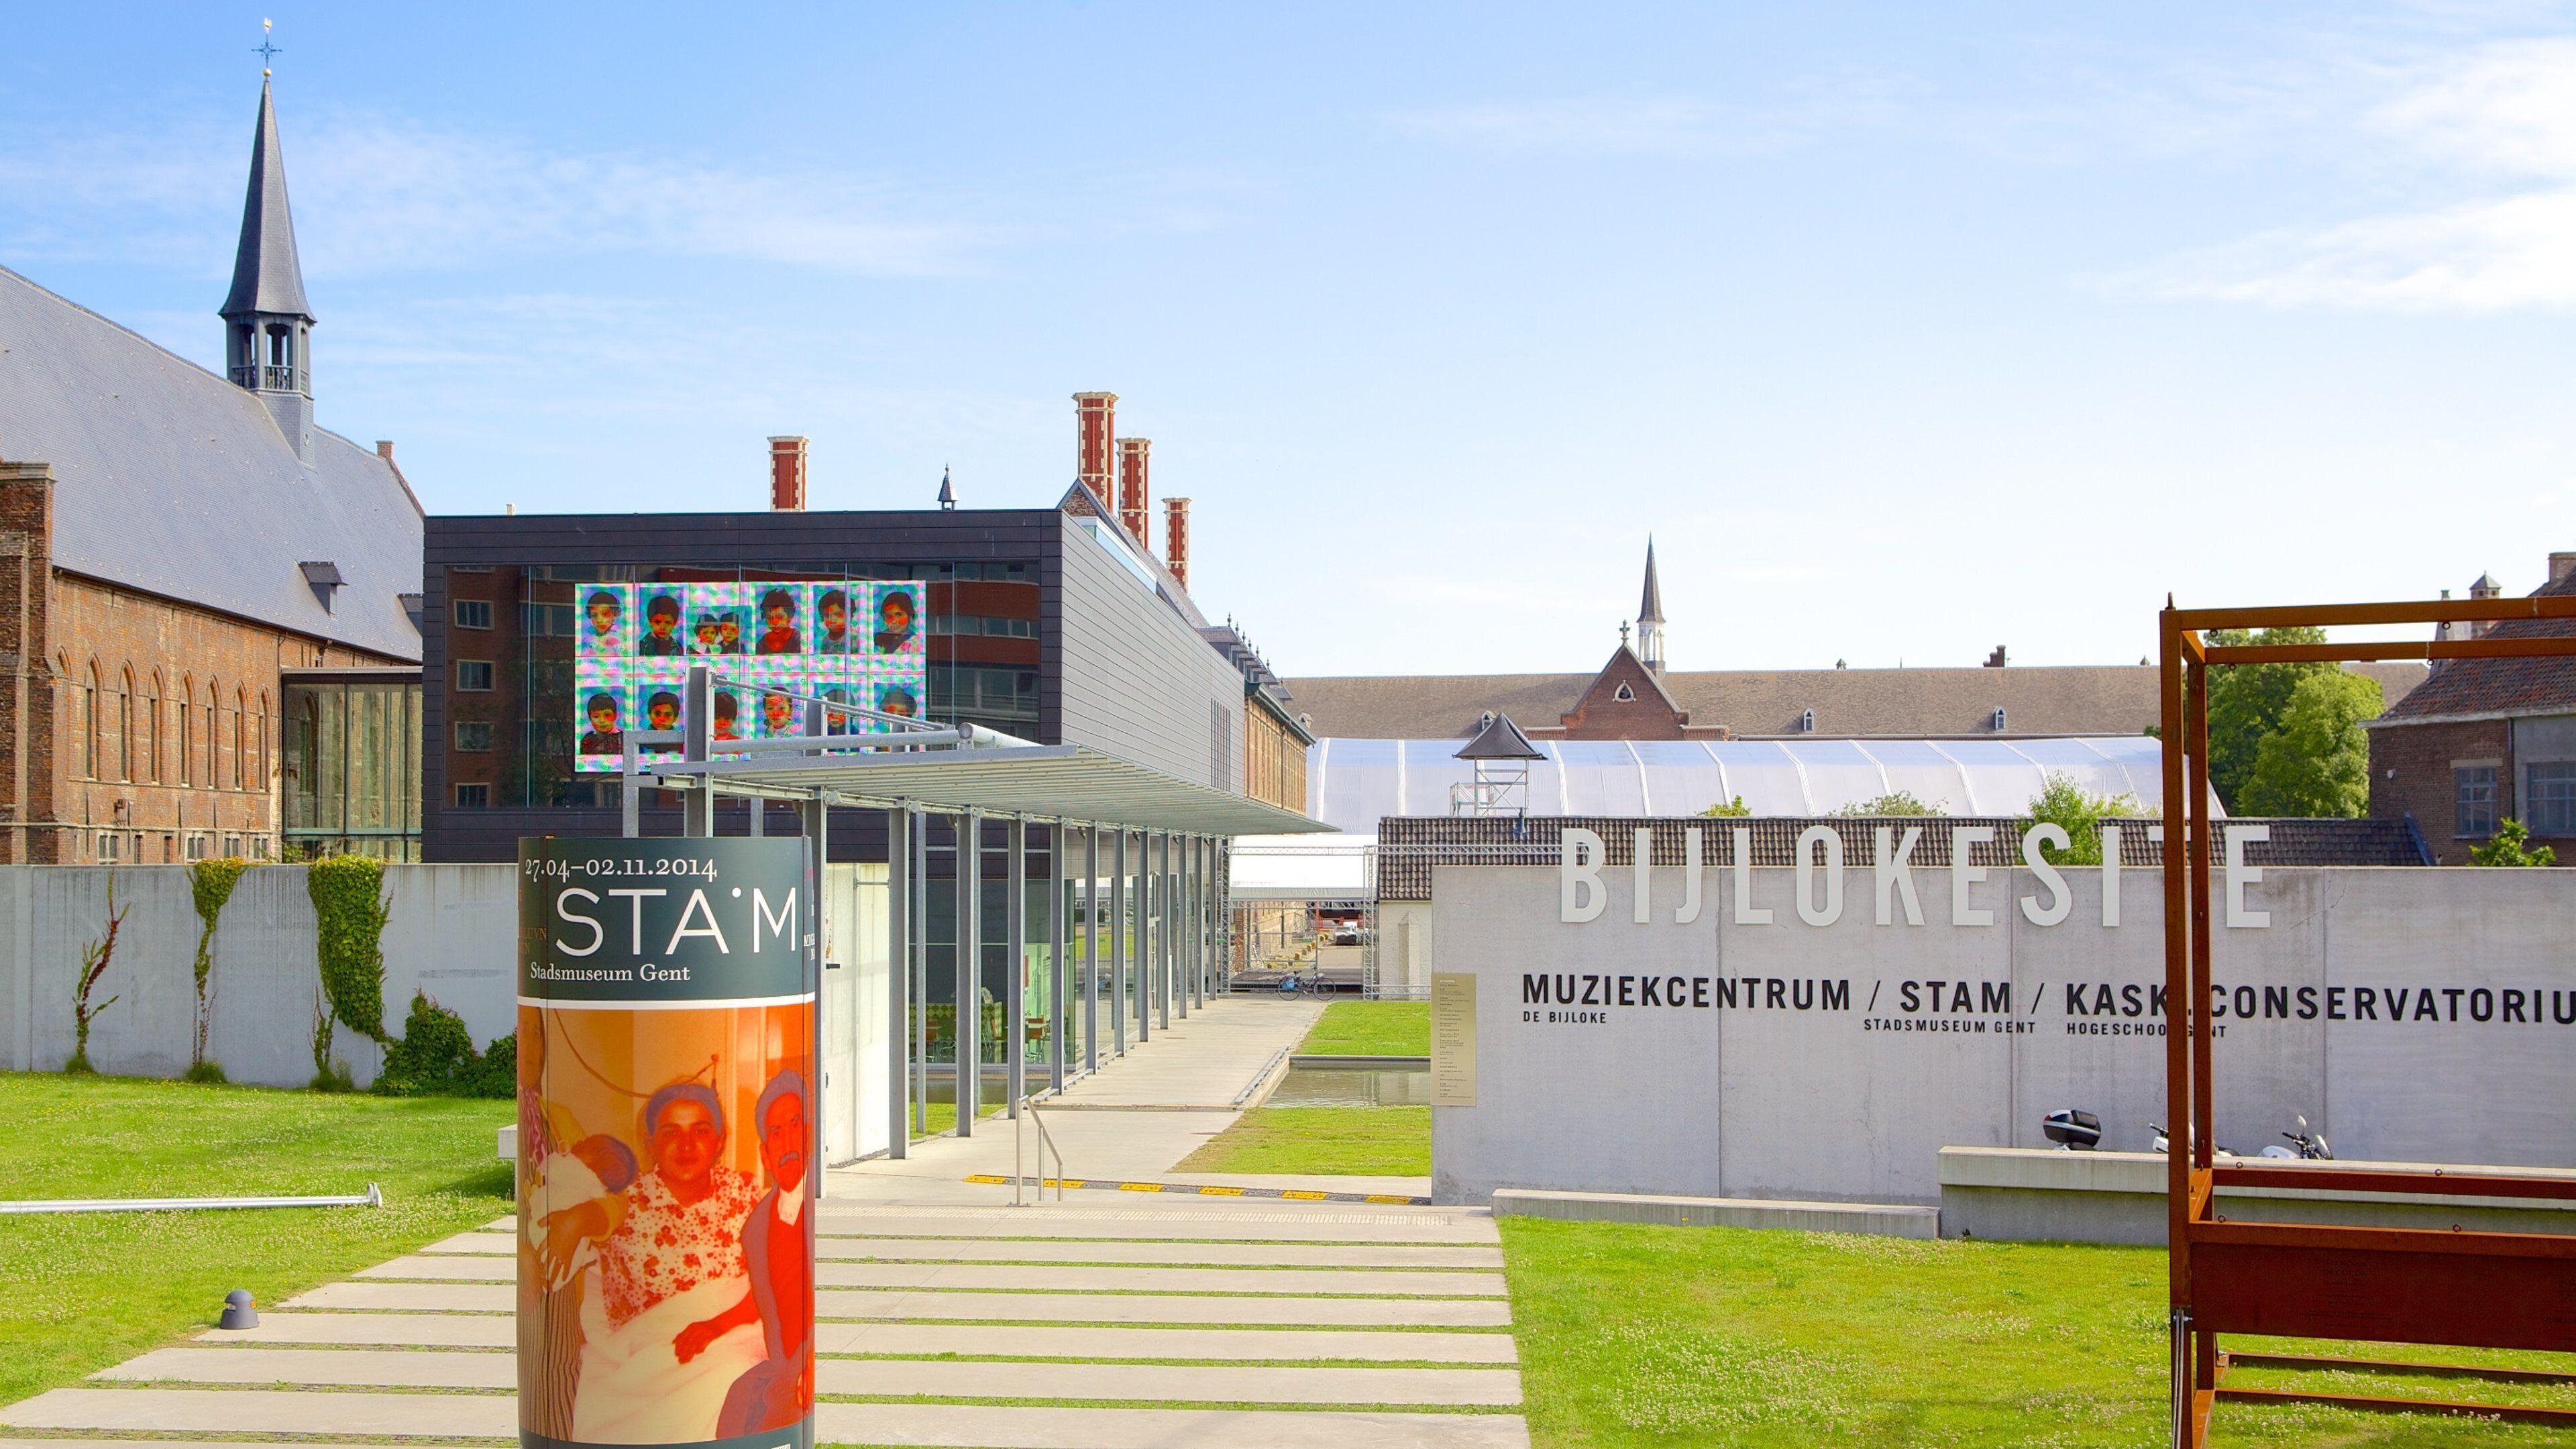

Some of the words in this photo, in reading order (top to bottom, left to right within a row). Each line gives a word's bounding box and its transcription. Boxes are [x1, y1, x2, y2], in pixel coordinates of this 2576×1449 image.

[530, 962, 633, 981] Stadsmuseum
[640, 963, 690, 981] Gent
[1523, 974, 1850, 1011] MUZIEKCENTRUM
[1900, 980, 2010, 1014] STAM
[2066, 983, 2167, 1018] KASK
[1523, 1010, 1540, 1022] DE
[1549, 1012, 1607, 1024] BIJLOKE
[1864, 1018, 1986, 1033] STADSMUSEUM
[1994, 1020, 2036, 1034] GENT
[2067, 1022, 2167, 1036] HOGESCHOO
